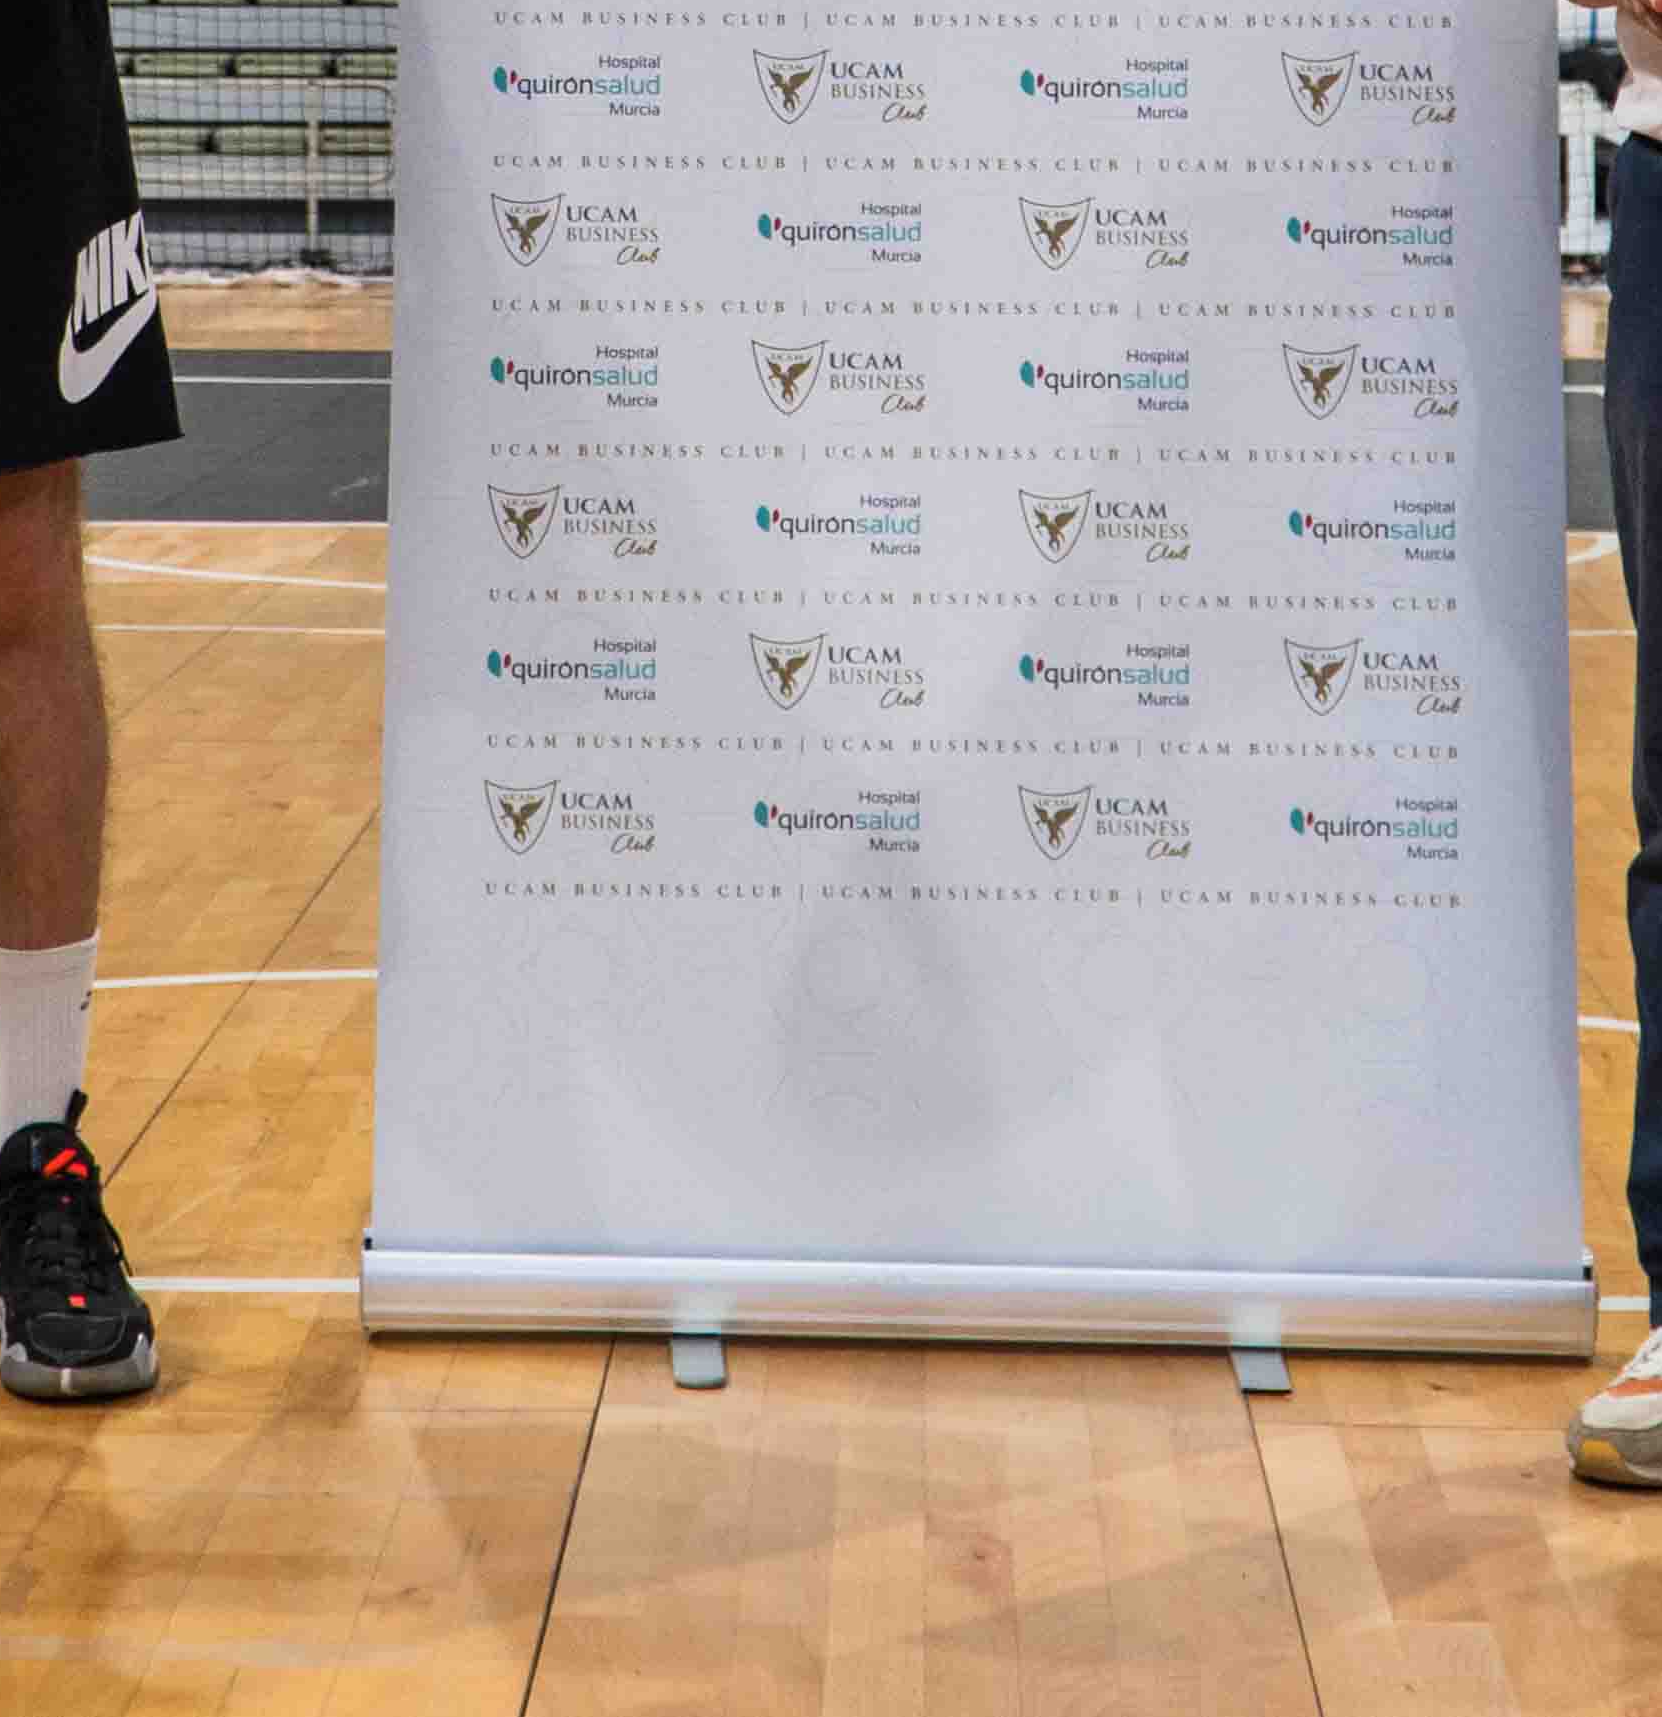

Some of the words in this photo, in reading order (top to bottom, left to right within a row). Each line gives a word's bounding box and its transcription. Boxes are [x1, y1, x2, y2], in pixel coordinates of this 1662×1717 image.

[598, 54, 661, 71] Hospital
[831, 61, 904, 80] UCAM
[1125, 57, 1189, 74] Hospital
[1360, 63, 1433, 82] UCAM
[831, 83, 926, 100] BUSINESS
[1360, 85, 1455, 103] BUSINESS
[609, 102, 660, 116] Murcia
[1137, 105, 1189, 119] Murcia
[73, 208, 152, 334] NIK
[492, 298, 562, 313] UCAM
[579, 298, 705, 313] BUSINESS
[720, 299, 786, 314] CLUB
[825, 299, 895, 315] UCAM
[913, 300, 1039, 316] BUSINESS
[1054, 301, 1120, 316] CLUB
[1159, 303, 1229, 318] UCAM
[1248, 303, 1374, 319] BUSINESS
[1389, 303, 1455, 318] CLUB
[595, 345, 659, 362] Hospital
[830, 352, 903, 371] UCAM
[1125, 348, 1189, 365] Hospital
[1361, 356, 1435, 375] UCAM
[830, 373, 925, 391] BUSINESS
[1362, 378, 1458, 396] BUSINESS
[607, 393, 658, 408] Murcia
[1137, 397, 1189, 411] Murcia
[563, 497, 635, 516] UCAM
[860, 494, 922, 510] Hospital
[1095, 500, 1168, 520] UCAM
[1394, 499, 1456, 515] Hospital
[563, 518, 657, 535] BUSINESS
[1095, 522, 1190, 540] BUSINESS
[871, 541, 921, 556] Murcia
[1406, 547, 1456, 562] Murcia
[487, 734, 558, 750] UCAM
[575, 735, 702, 751] BUSINESS
[718, 736, 784, 752] CLUB
[822, 736, 893, 752] UCAM
[912, 737, 1038, 753] BUSINESS
[1054, 738, 1120, 754] CLUB
[1160, 740, 1231, 756] UCAM
[1249, 742, 1376, 759] BUSINESS
[1392, 744, 1459, 759] CLUB
[561, 792, 633, 811] UCAM
[858, 790, 920, 807] Hospital
[1096, 797, 1169, 817] UCAM
[1395, 797, 1458, 814] Hospital
[561, 814, 655, 831] BUSINESS
[1096, 819, 1191, 837] BUSINESS
[869, 838, 920, 853] Murcia
[1407, 845, 1458, 860] Murcia
